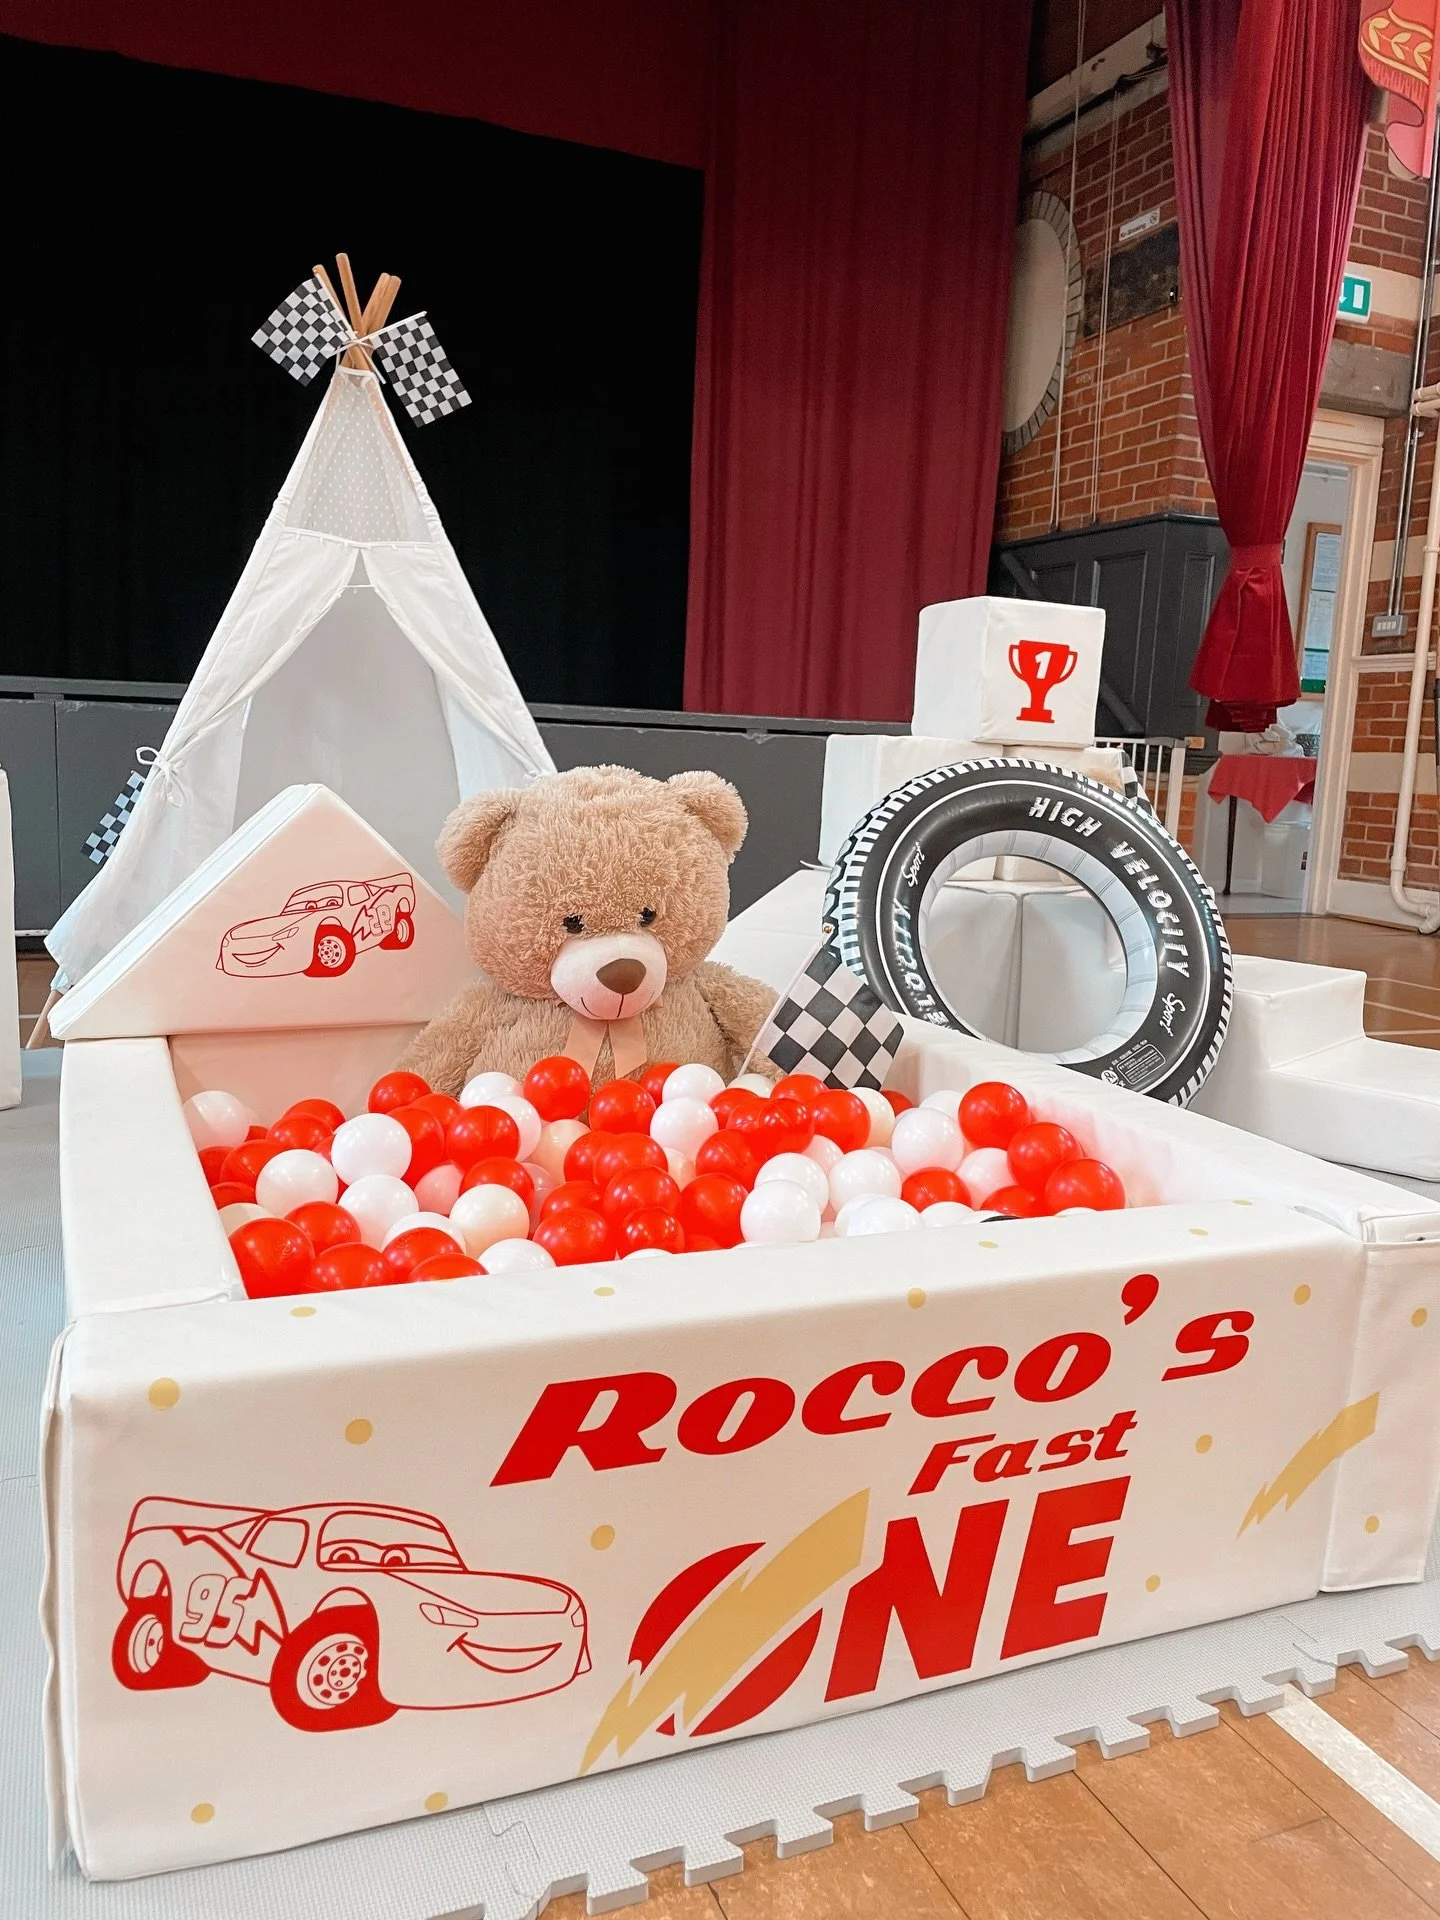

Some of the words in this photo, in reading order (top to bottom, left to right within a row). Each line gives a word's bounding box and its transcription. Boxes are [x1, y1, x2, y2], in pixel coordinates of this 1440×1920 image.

[1035, 651, 1052, 680] 1
[901, 841, 925, 888] Sport
[1028, 797, 1103, 839] HIGH
[1110, 840, 1190, 979] VELOCITY
[893, 897, 953, 1030] ELOCITY
[1159, 992, 1186, 1038] Sport
[491, 1274, 1256, 1487] Rocco's
[908, 1410, 1138, 1496] Fast
[179, 1573, 253, 1649] 95
[628, 1475, 1132, 1738] ONE
